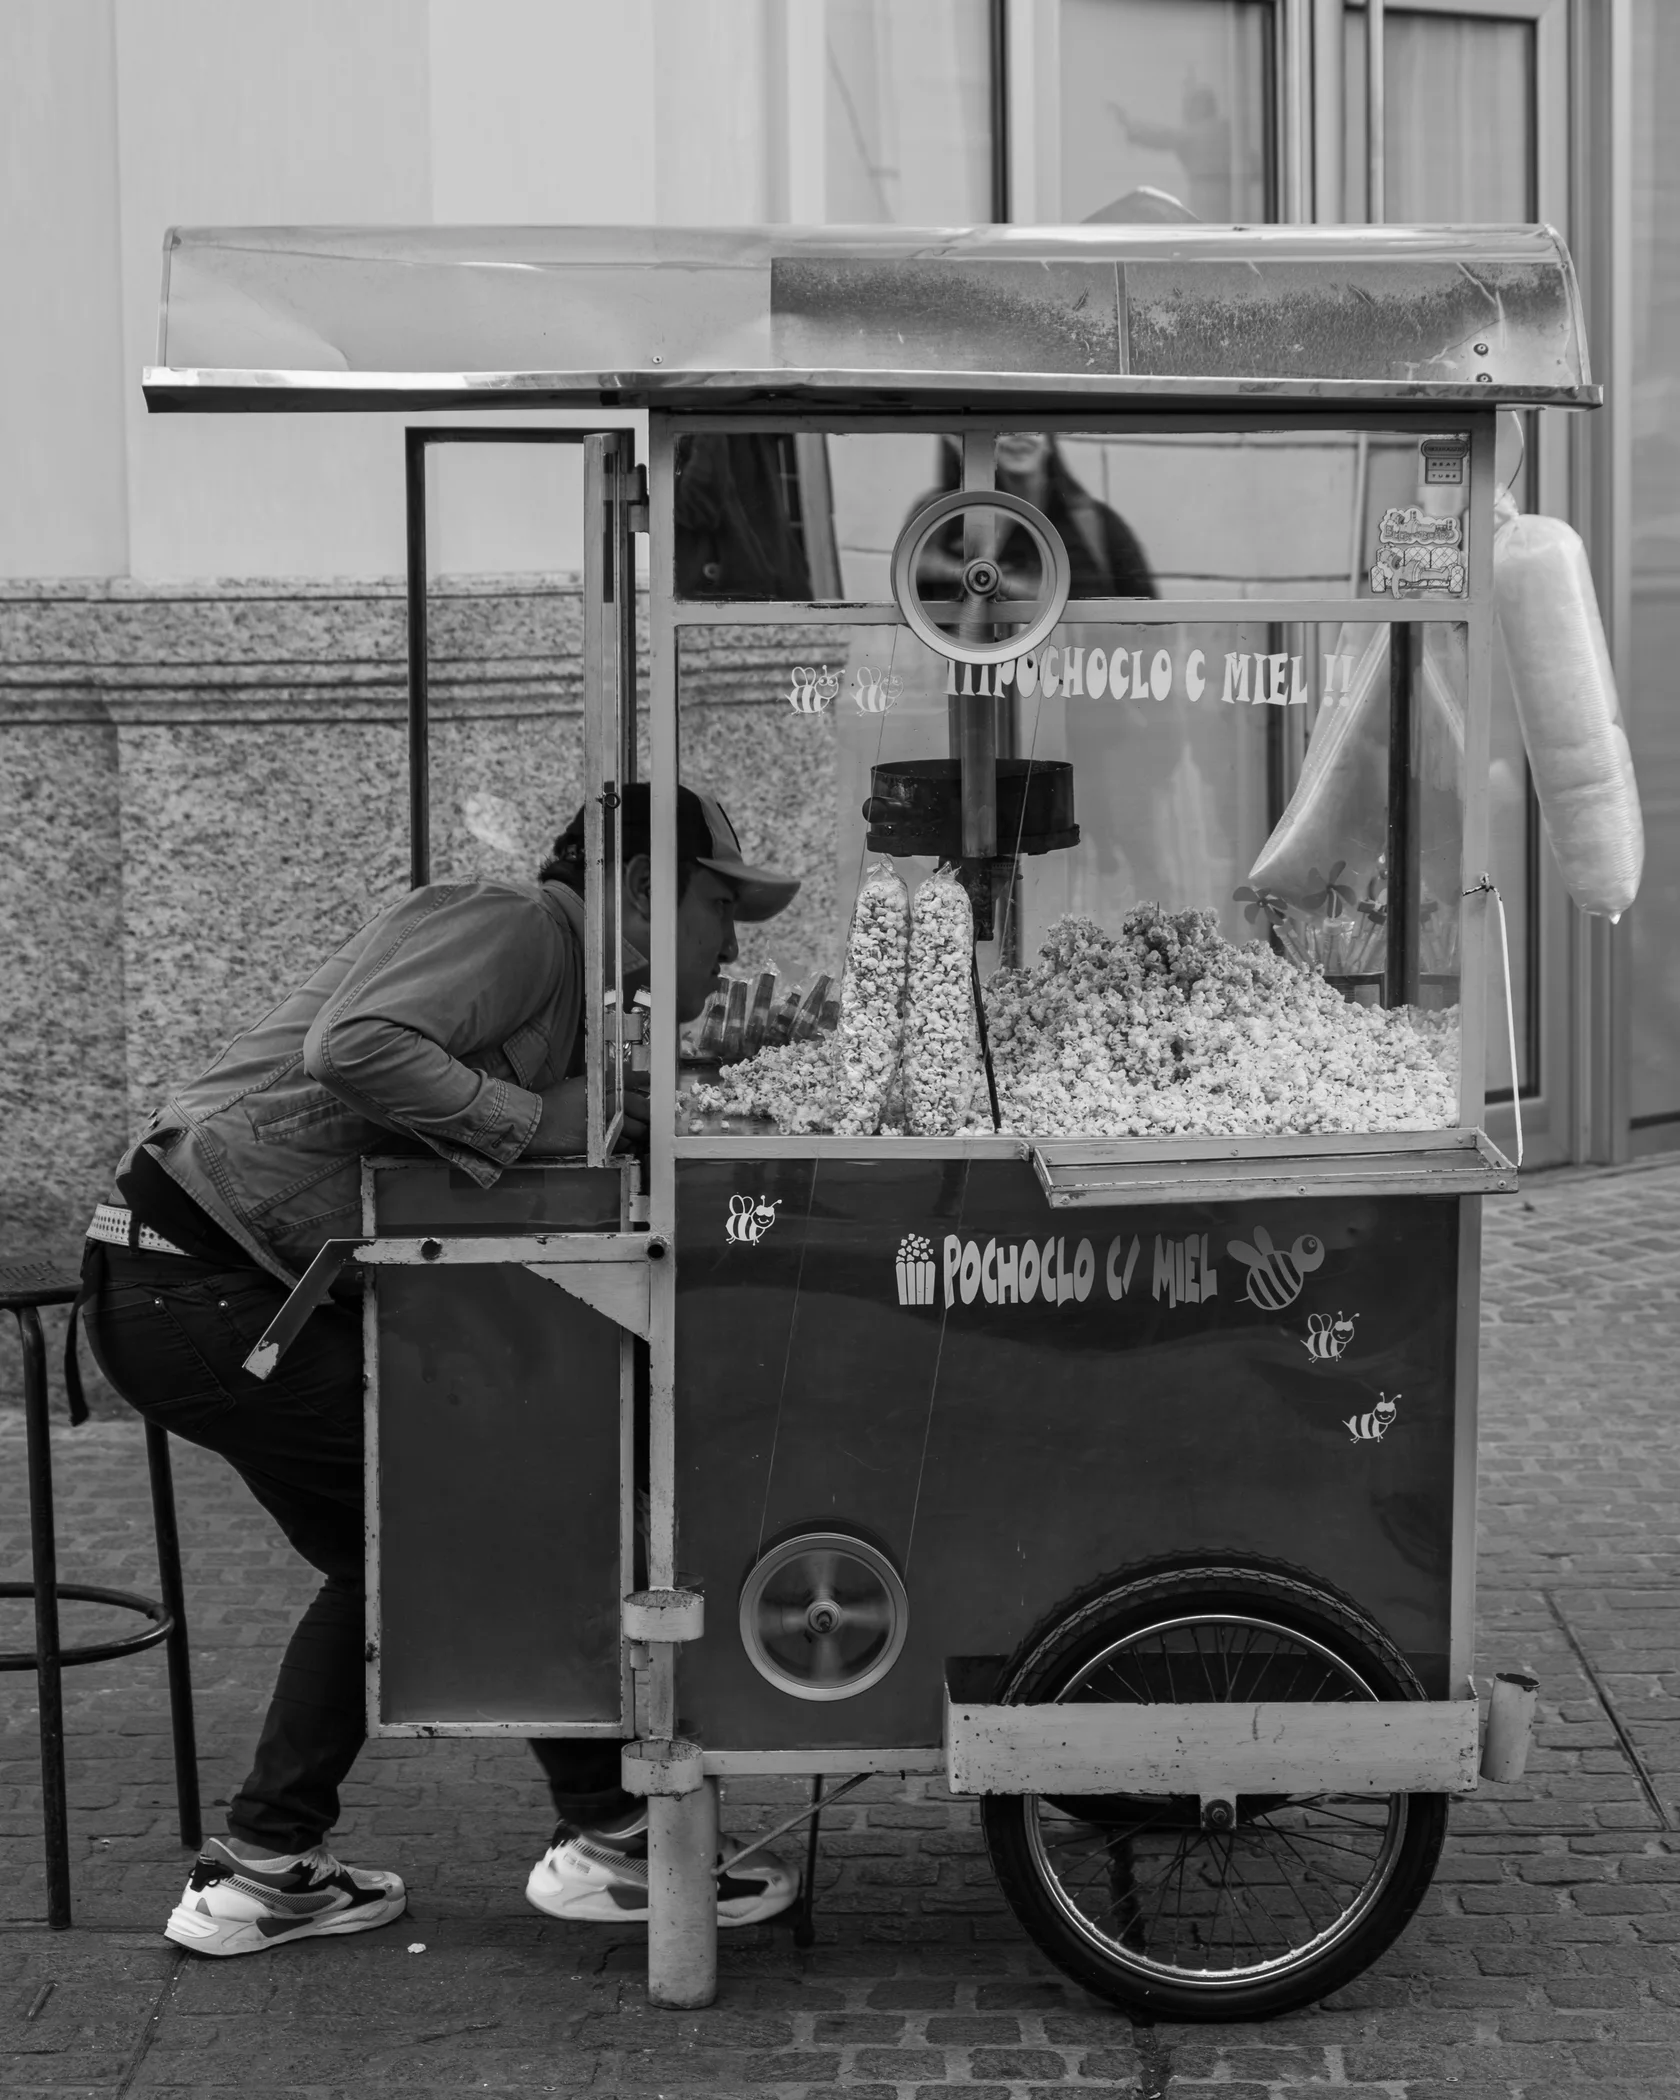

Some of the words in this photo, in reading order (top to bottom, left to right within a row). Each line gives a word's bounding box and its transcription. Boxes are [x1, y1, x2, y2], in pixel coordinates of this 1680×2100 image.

[1221, 651, 1307, 706] MIEL
[944, 1234, 1095, 1309] POCHOCLO
[1152, 1233, 1218, 1309] MIEL
